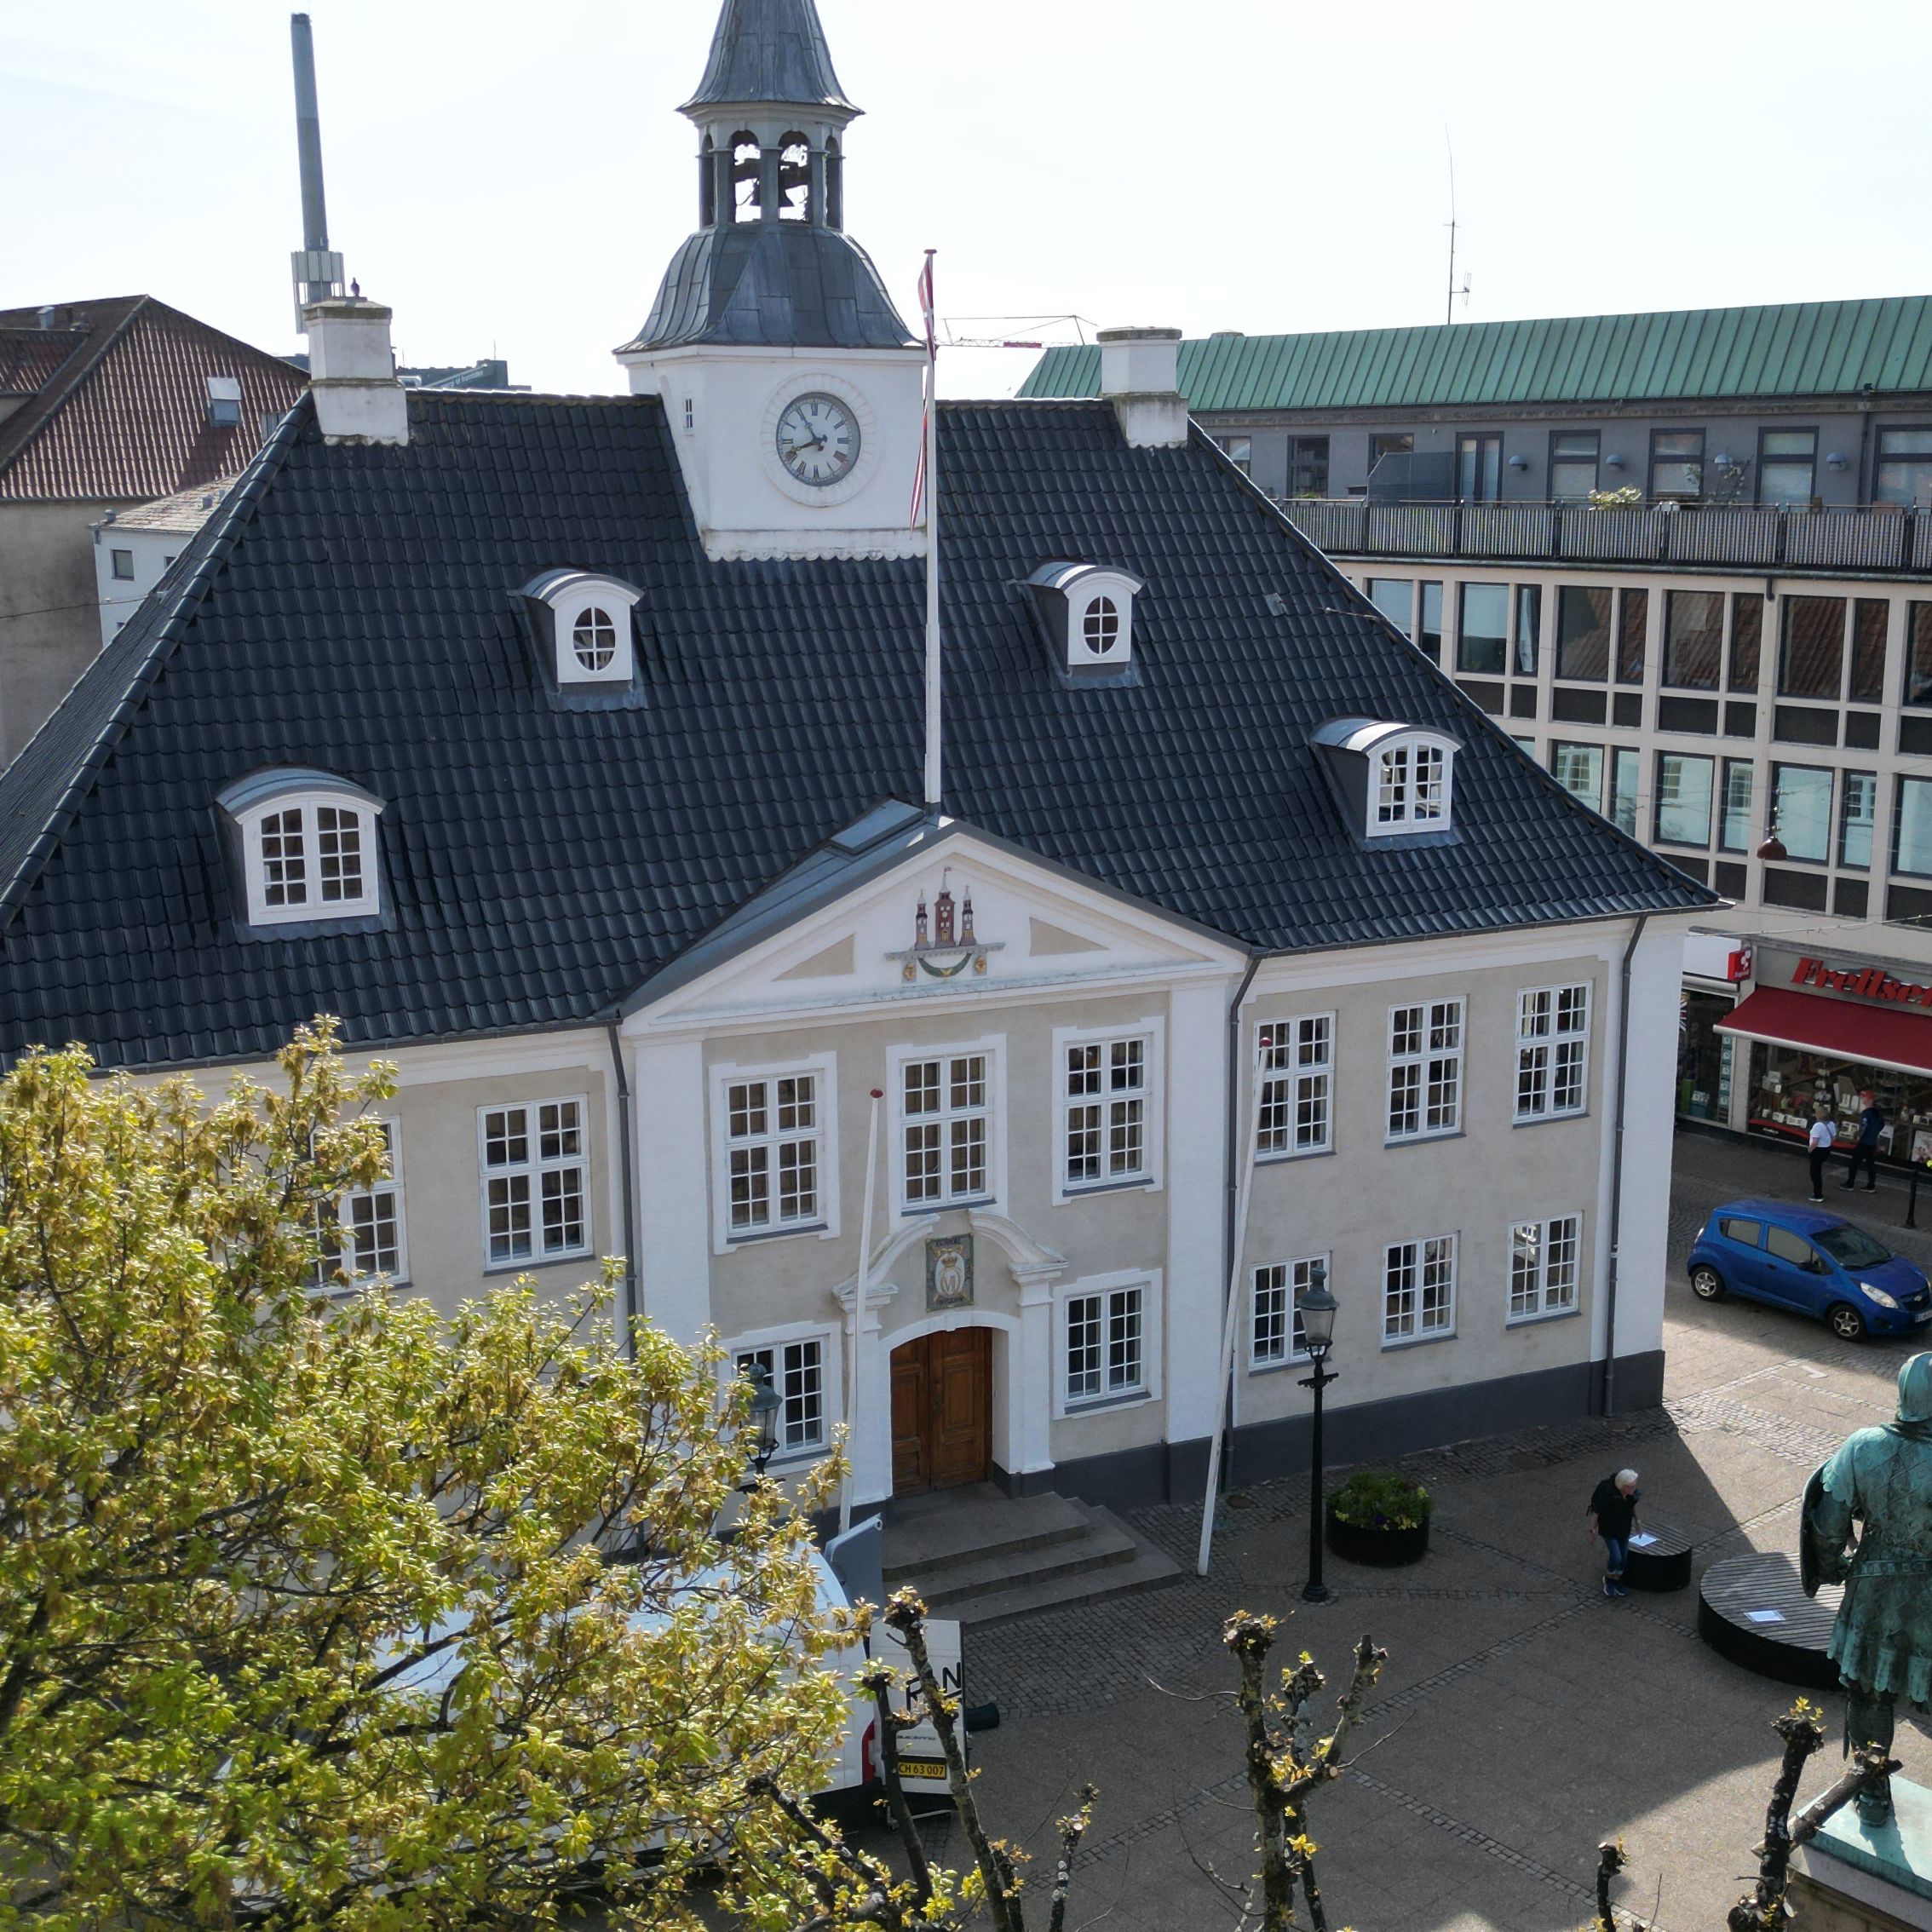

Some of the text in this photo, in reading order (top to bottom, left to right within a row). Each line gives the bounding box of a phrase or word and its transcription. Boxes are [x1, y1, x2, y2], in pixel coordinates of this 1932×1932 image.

[899, 1763, 945, 1775] CH 63 007
